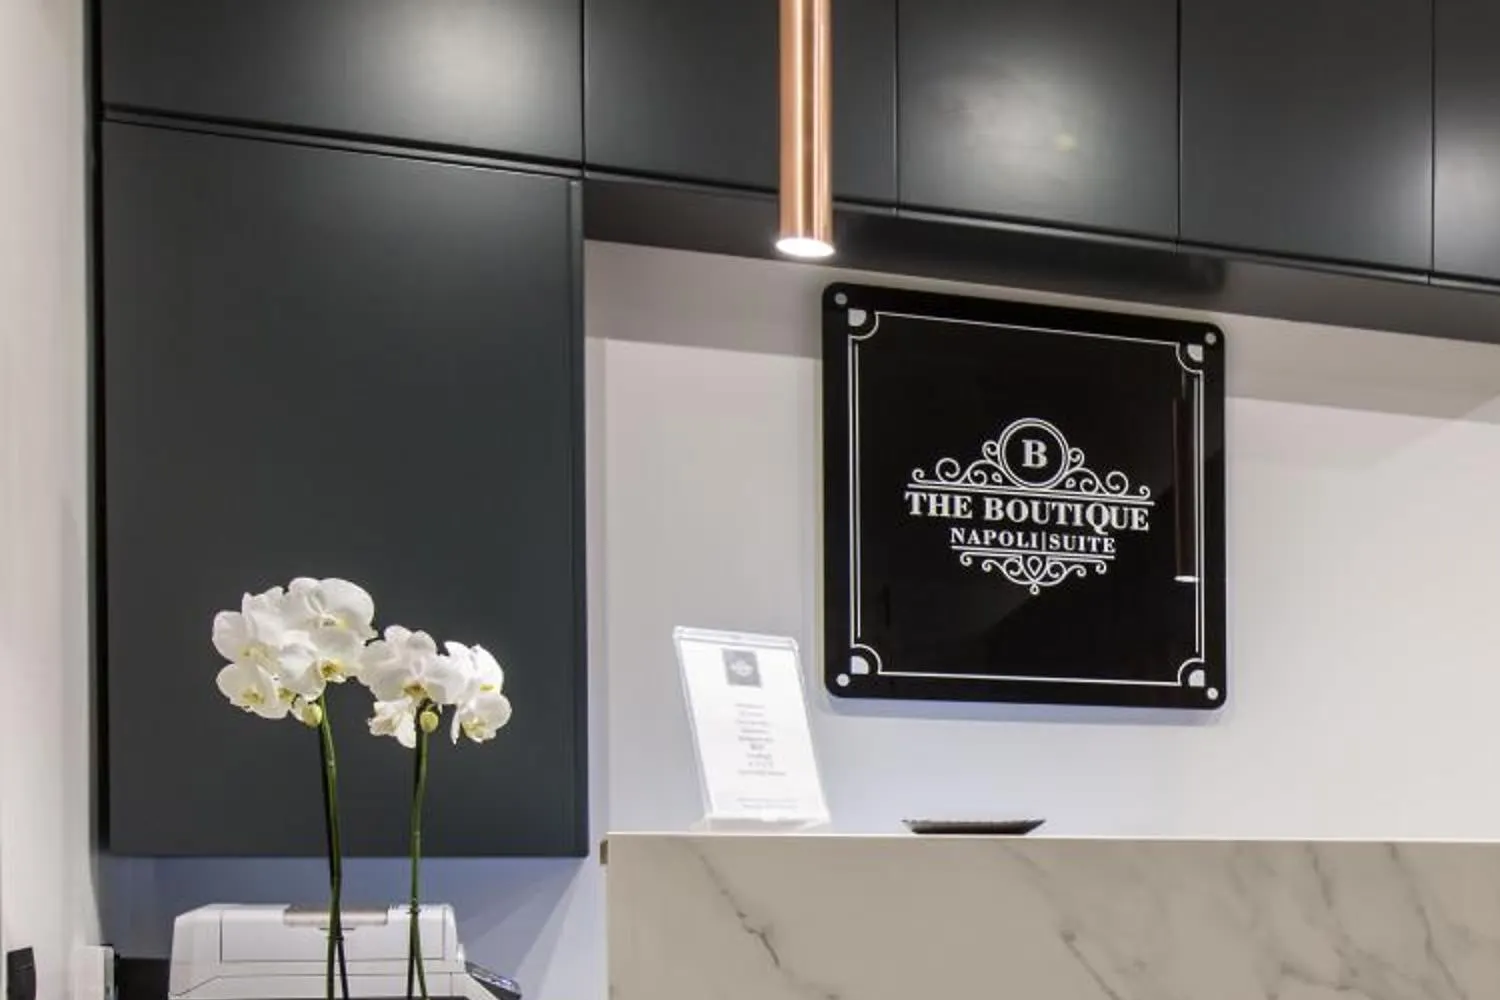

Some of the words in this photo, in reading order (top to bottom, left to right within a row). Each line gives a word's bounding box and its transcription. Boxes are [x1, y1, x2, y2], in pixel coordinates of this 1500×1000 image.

[1021, 439, 1048, 469] B
[905, 491, 973, 519] THE
[984, 497, 1149, 535] BOUTIQUE
